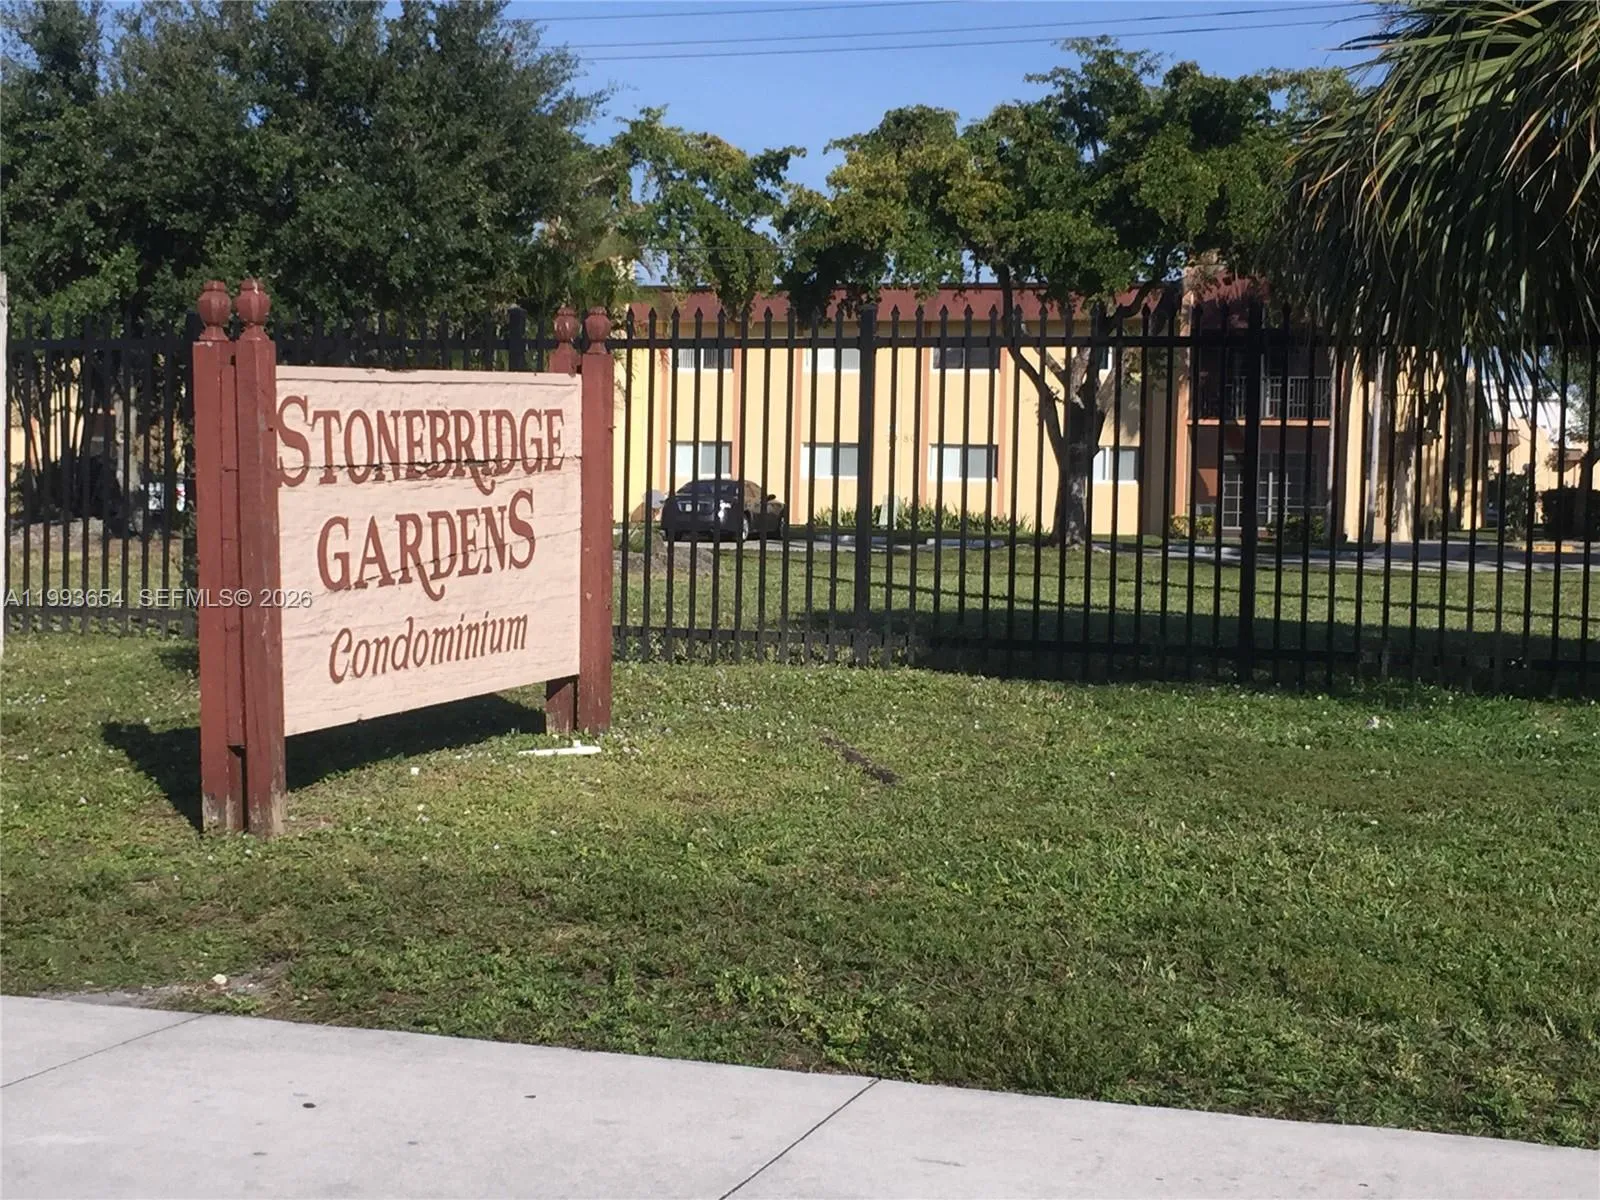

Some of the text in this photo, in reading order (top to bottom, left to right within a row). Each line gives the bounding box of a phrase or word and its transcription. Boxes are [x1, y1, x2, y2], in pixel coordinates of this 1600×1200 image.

[276, 395, 565, 495] STONEBRIDGE
[317, 489, 536, 601] GARDENS
[328, 611, 528, 684] Condominium
